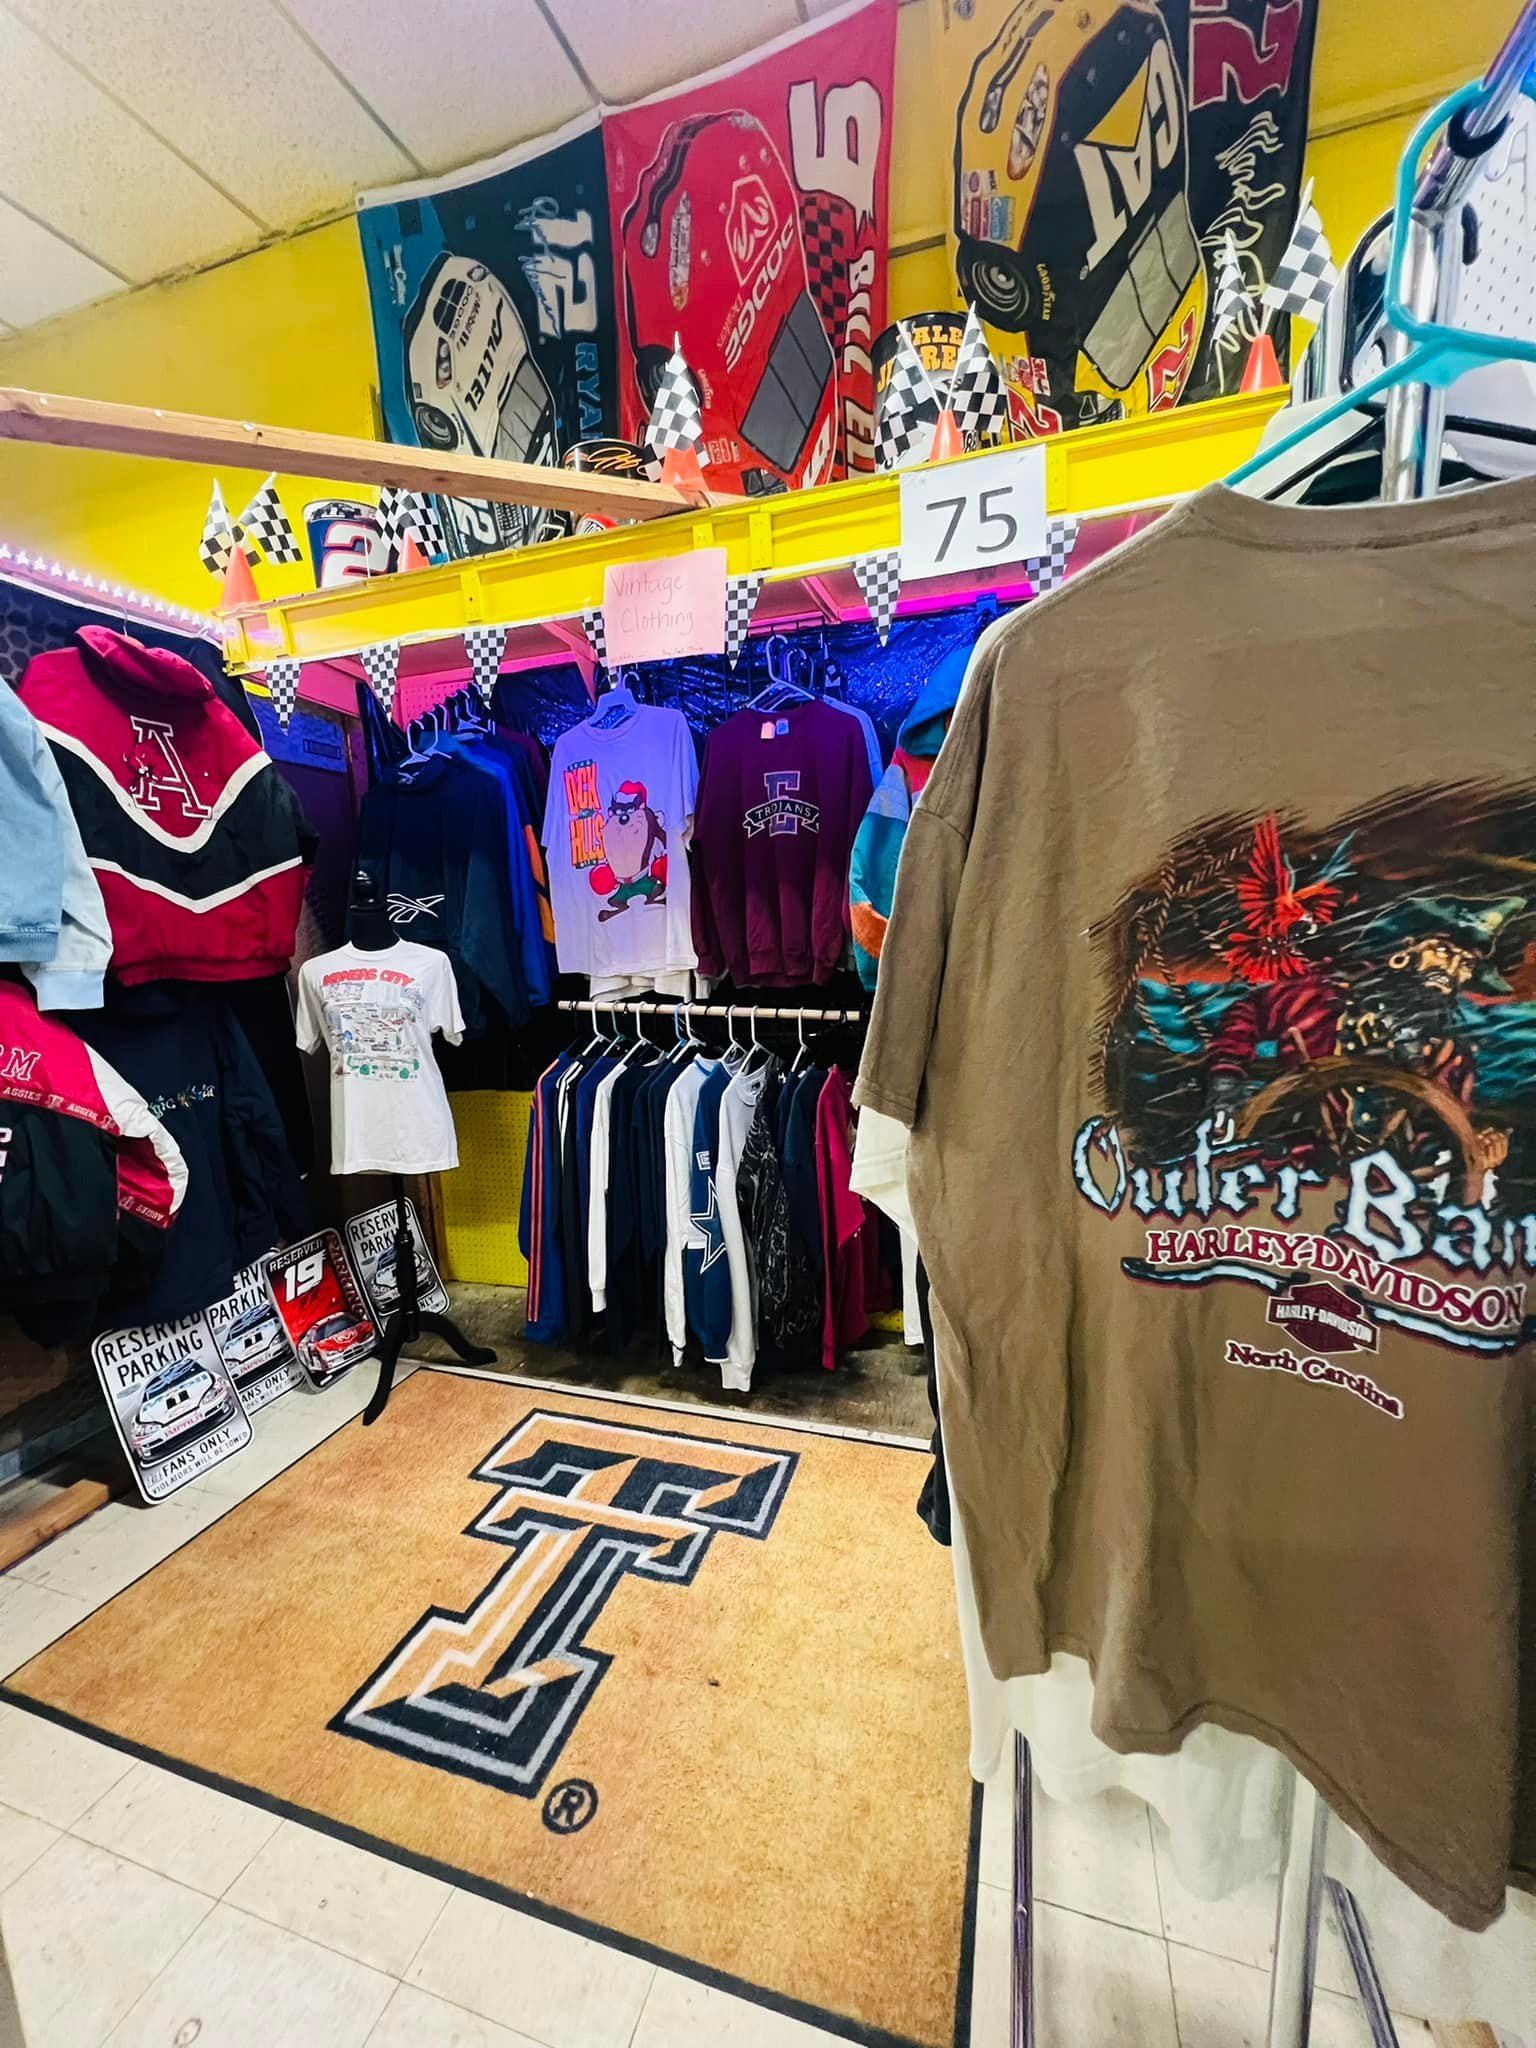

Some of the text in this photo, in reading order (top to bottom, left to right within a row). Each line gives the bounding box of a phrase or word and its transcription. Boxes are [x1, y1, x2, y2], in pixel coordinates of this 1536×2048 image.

[1189, 0, 1303, 111] 2
[788, 79, 884, 236] 9
[1073, 39, 1181, 272] CAT
[532, 208, 598, 339] 12
[724, 213, 794, 374] DODGE
[1034, 262, 1055, 322] GOODYEAR
[450, 285, 474, 340] DODGE
[845, 249, 876, 375] BILL
[464, 297, 504, 412] ALLTEL
[925, 486, 1019, 563] 75
[319, 523, 393, 588] 2
[609, 571, 684, 603] Vintage
[620, 608, 695, 637] Clothing
[130, 715, 212, 819] A
[754, 801, 812, 820] TROJANS
[3, 1086, 42, 1102] AGGIES
[66, 1102, 99, 1121] AGGIES
[1071, 1111, 1330, 1220] Outer
[350, 1205, 411, 1242] RESERVD
[269, 1239, 323, 1273] RESERVED
[284, 1249, 327, 1302] 19
[1146, 1225, 1527, 1330] HARLEY-DAVIDSON
[101, 1314, 200, 1366] RESERVED
[1274, 1302, 1374, 1343] HARLEY-DAVIDSON
[117, 1329, 203, 1387] PARKING
[264, 1367, 291, 1391] ONLY
[1225, 1340, 1405, 1419] North Carolina
[152, 1465, 194, 1494] VIOLATORS
[194, 1453, 213, 1468] WILL
[226, 1431, 248, 1450] TOWED
[162, 1428, 231, 1478] FANS ONLY
